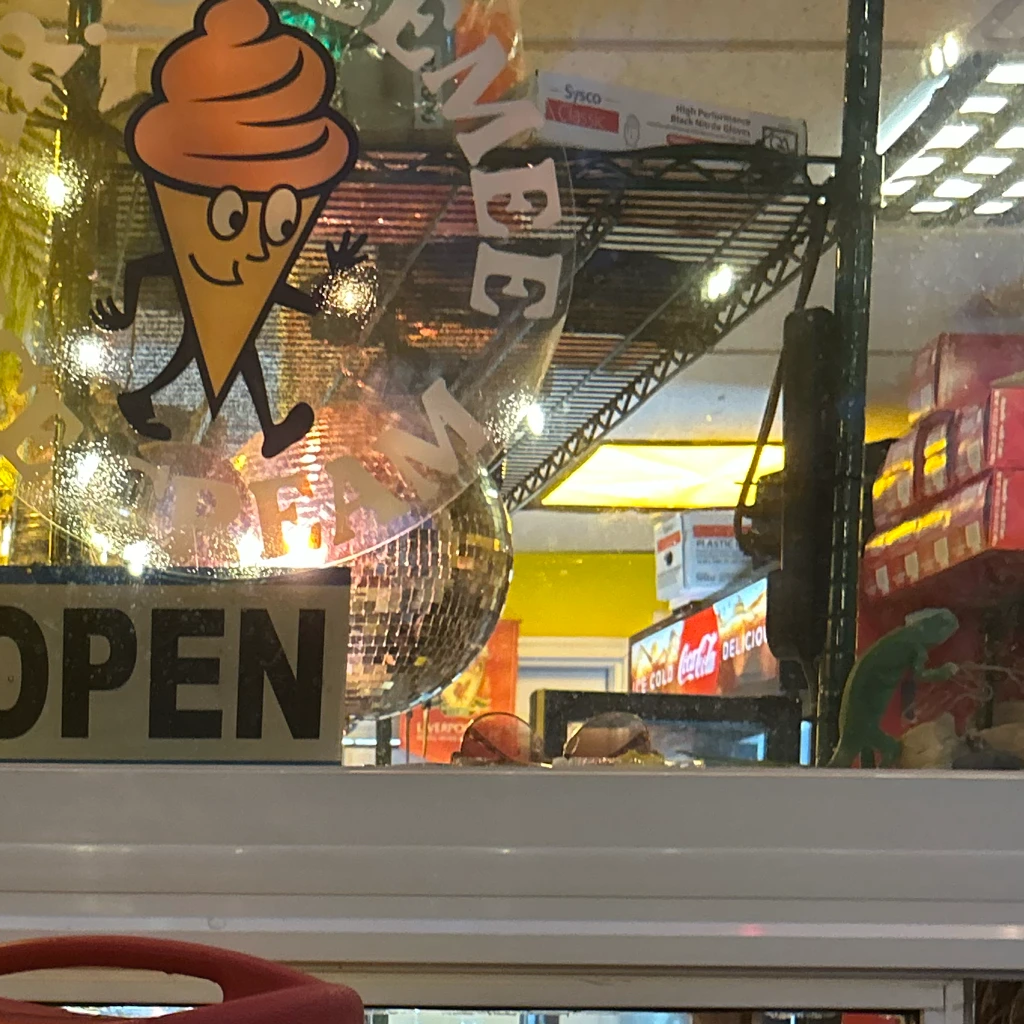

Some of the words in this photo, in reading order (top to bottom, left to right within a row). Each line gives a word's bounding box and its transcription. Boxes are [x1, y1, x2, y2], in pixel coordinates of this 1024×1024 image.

[564, 83, 603, 106] Sysco
[670, 114, 693, 126] Black
[676, 104, 696, 118] High
[698, 108, 751, 126] Performance
[286, 0, 562, 320] EMEE
[649, 665, 674, 691] COLD
[678, 631, 717, 687] Coca-Cola
